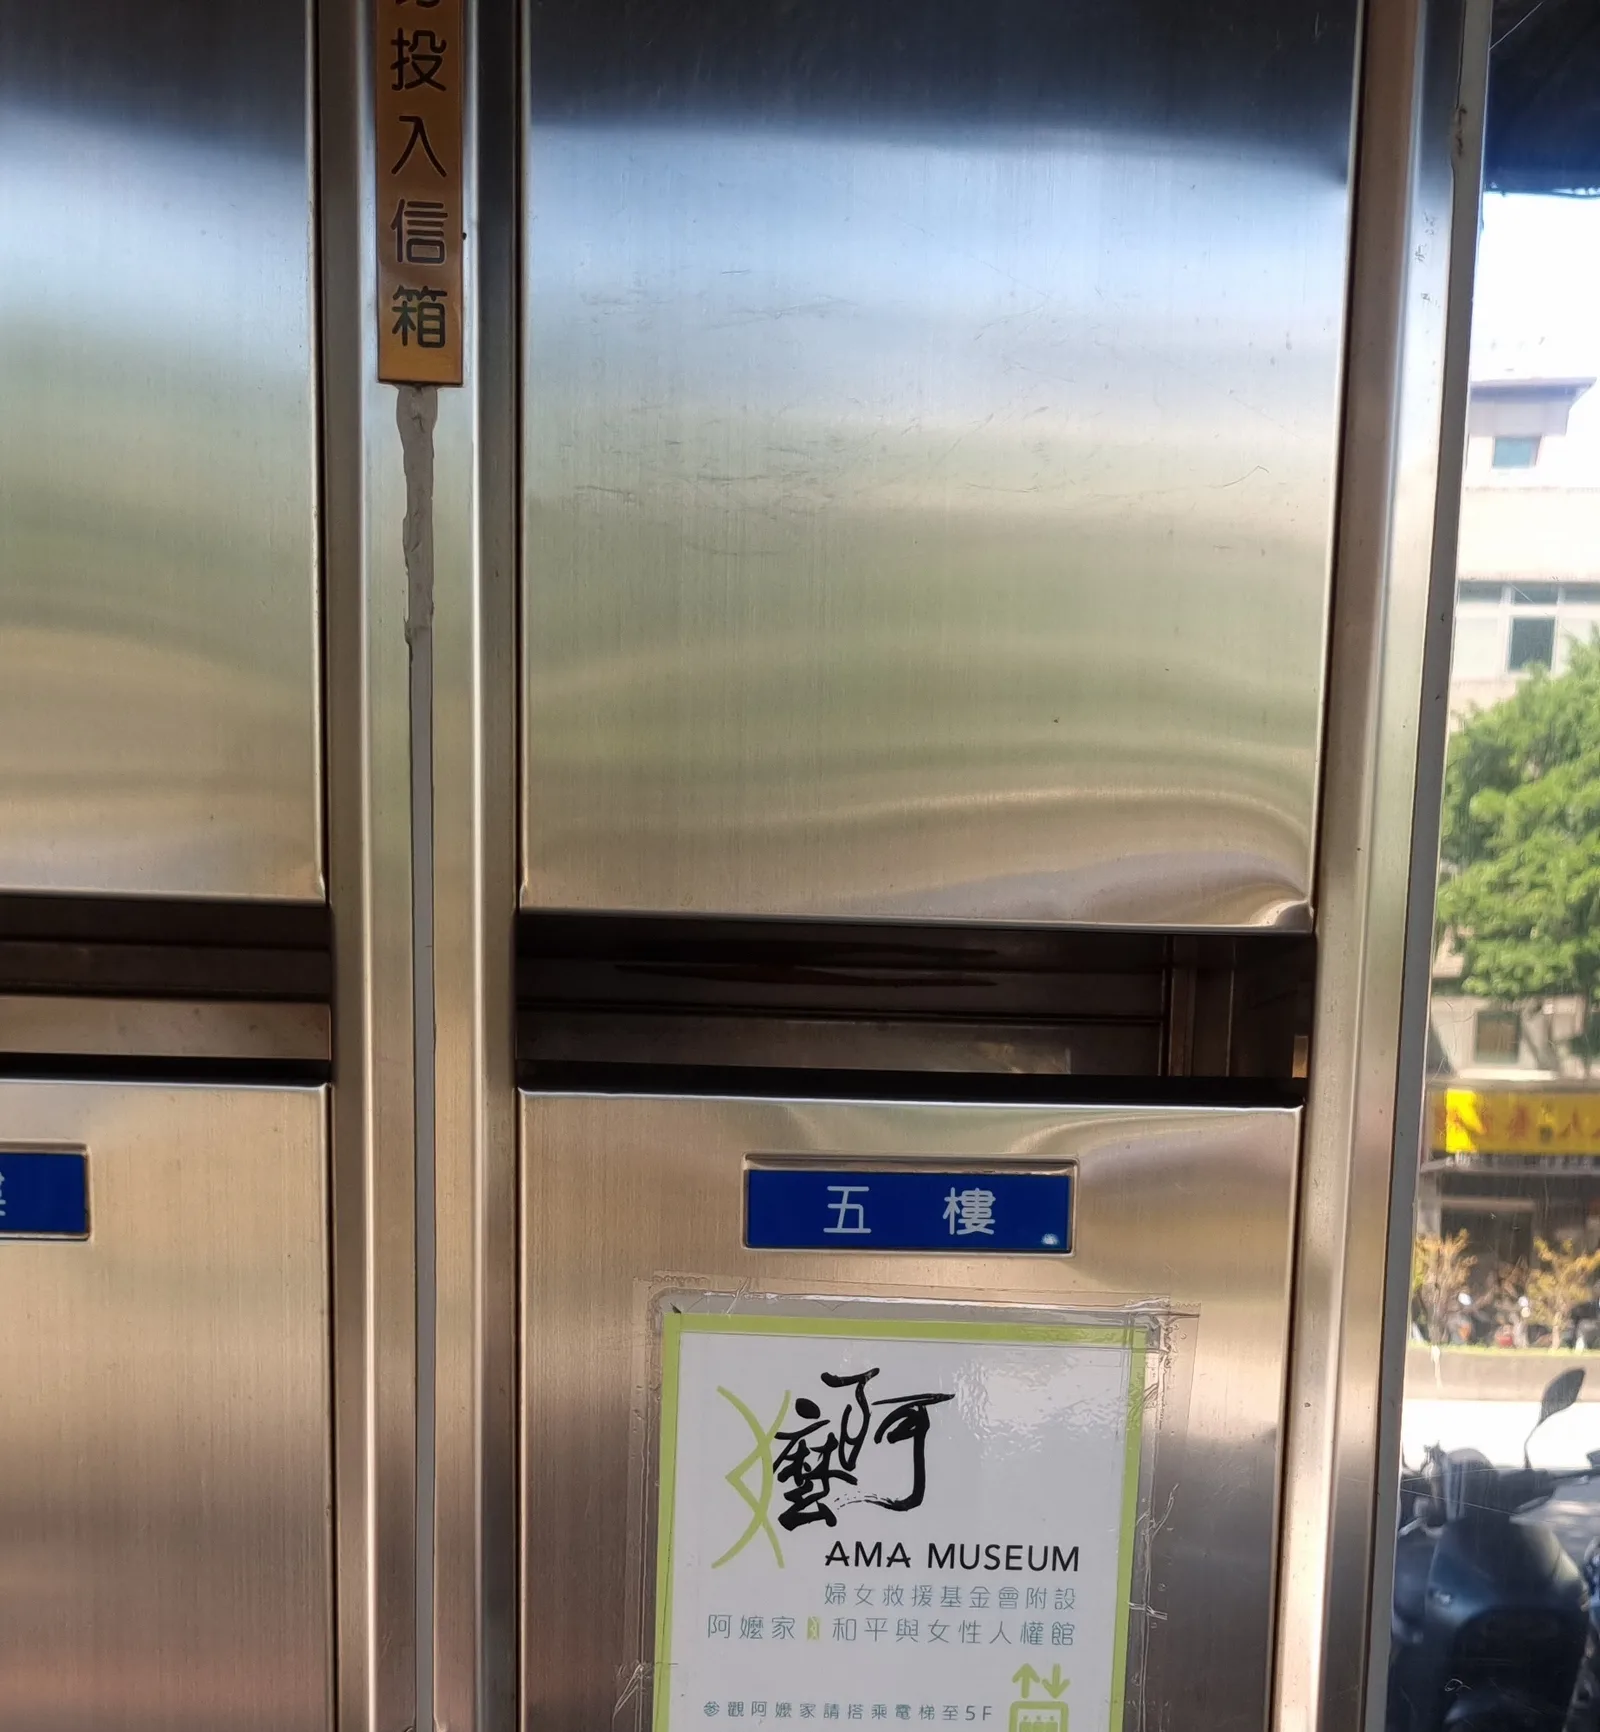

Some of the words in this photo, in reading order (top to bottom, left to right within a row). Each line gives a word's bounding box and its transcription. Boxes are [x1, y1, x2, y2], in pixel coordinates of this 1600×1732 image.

[389, 0, 449, 349] 投入信箱
[822, 1185, 997, 1236] 五樓
[824, 1540, 912, 1569] AMA
[927, 1542, 1080, 1573] MUSEUM
[824, 1582, 1077, 1611] 婦女救援基金會附設
[707, 1614, 796, 1641] 阿嬤家
[832, 1616, 1076, 1647] 和平與女性人權館
